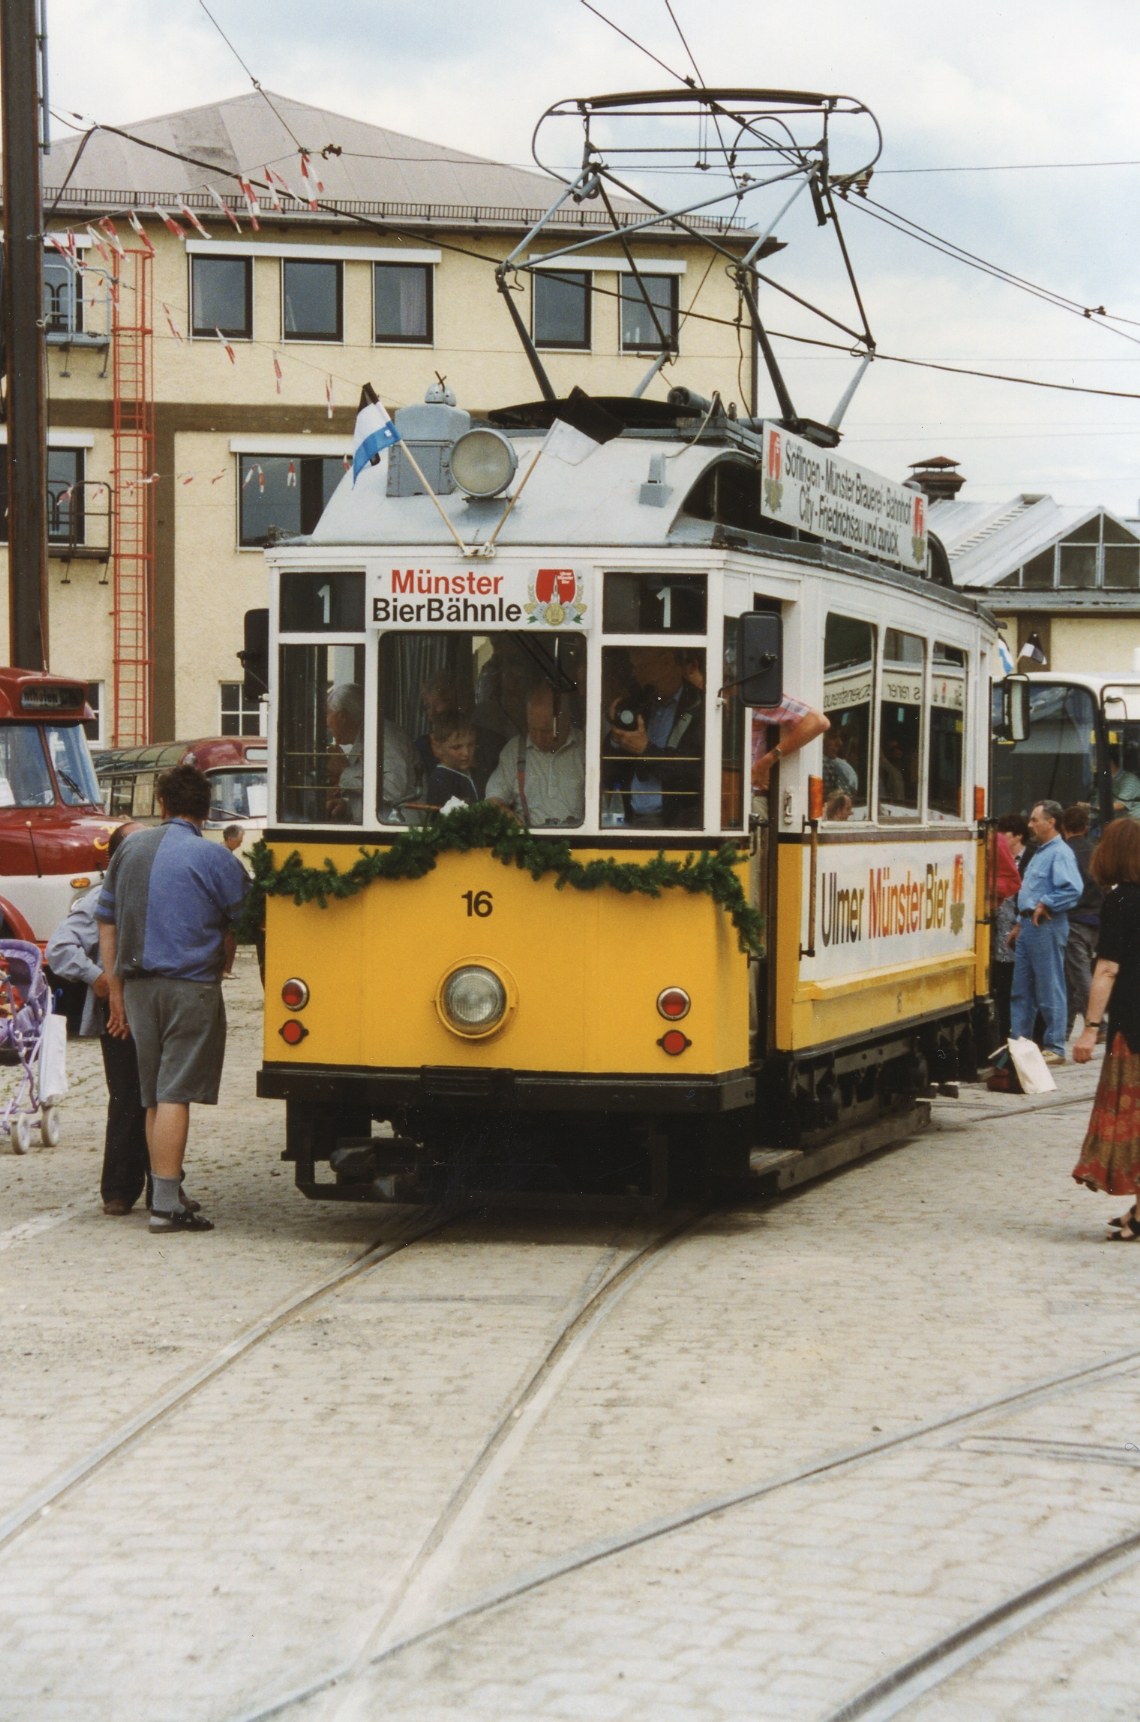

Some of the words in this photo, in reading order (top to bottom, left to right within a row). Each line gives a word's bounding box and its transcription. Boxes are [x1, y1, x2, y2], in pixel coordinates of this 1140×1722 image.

[800, 484, 814, 532] City
[819, 495, 863, 543] Friedrichsau
[864, 517, 878, 548] und
[886, 487, 912, 525] Bahnhof
[391, 569, 503, 595] Münster
[317, 584, 330, 624] 1
[372, 597, 522, 623] BierBähnle
[656, 586, 671, 628] 1
[461, 890, 493, 918] 16
[822, 871, 865, 947] Ulmer
